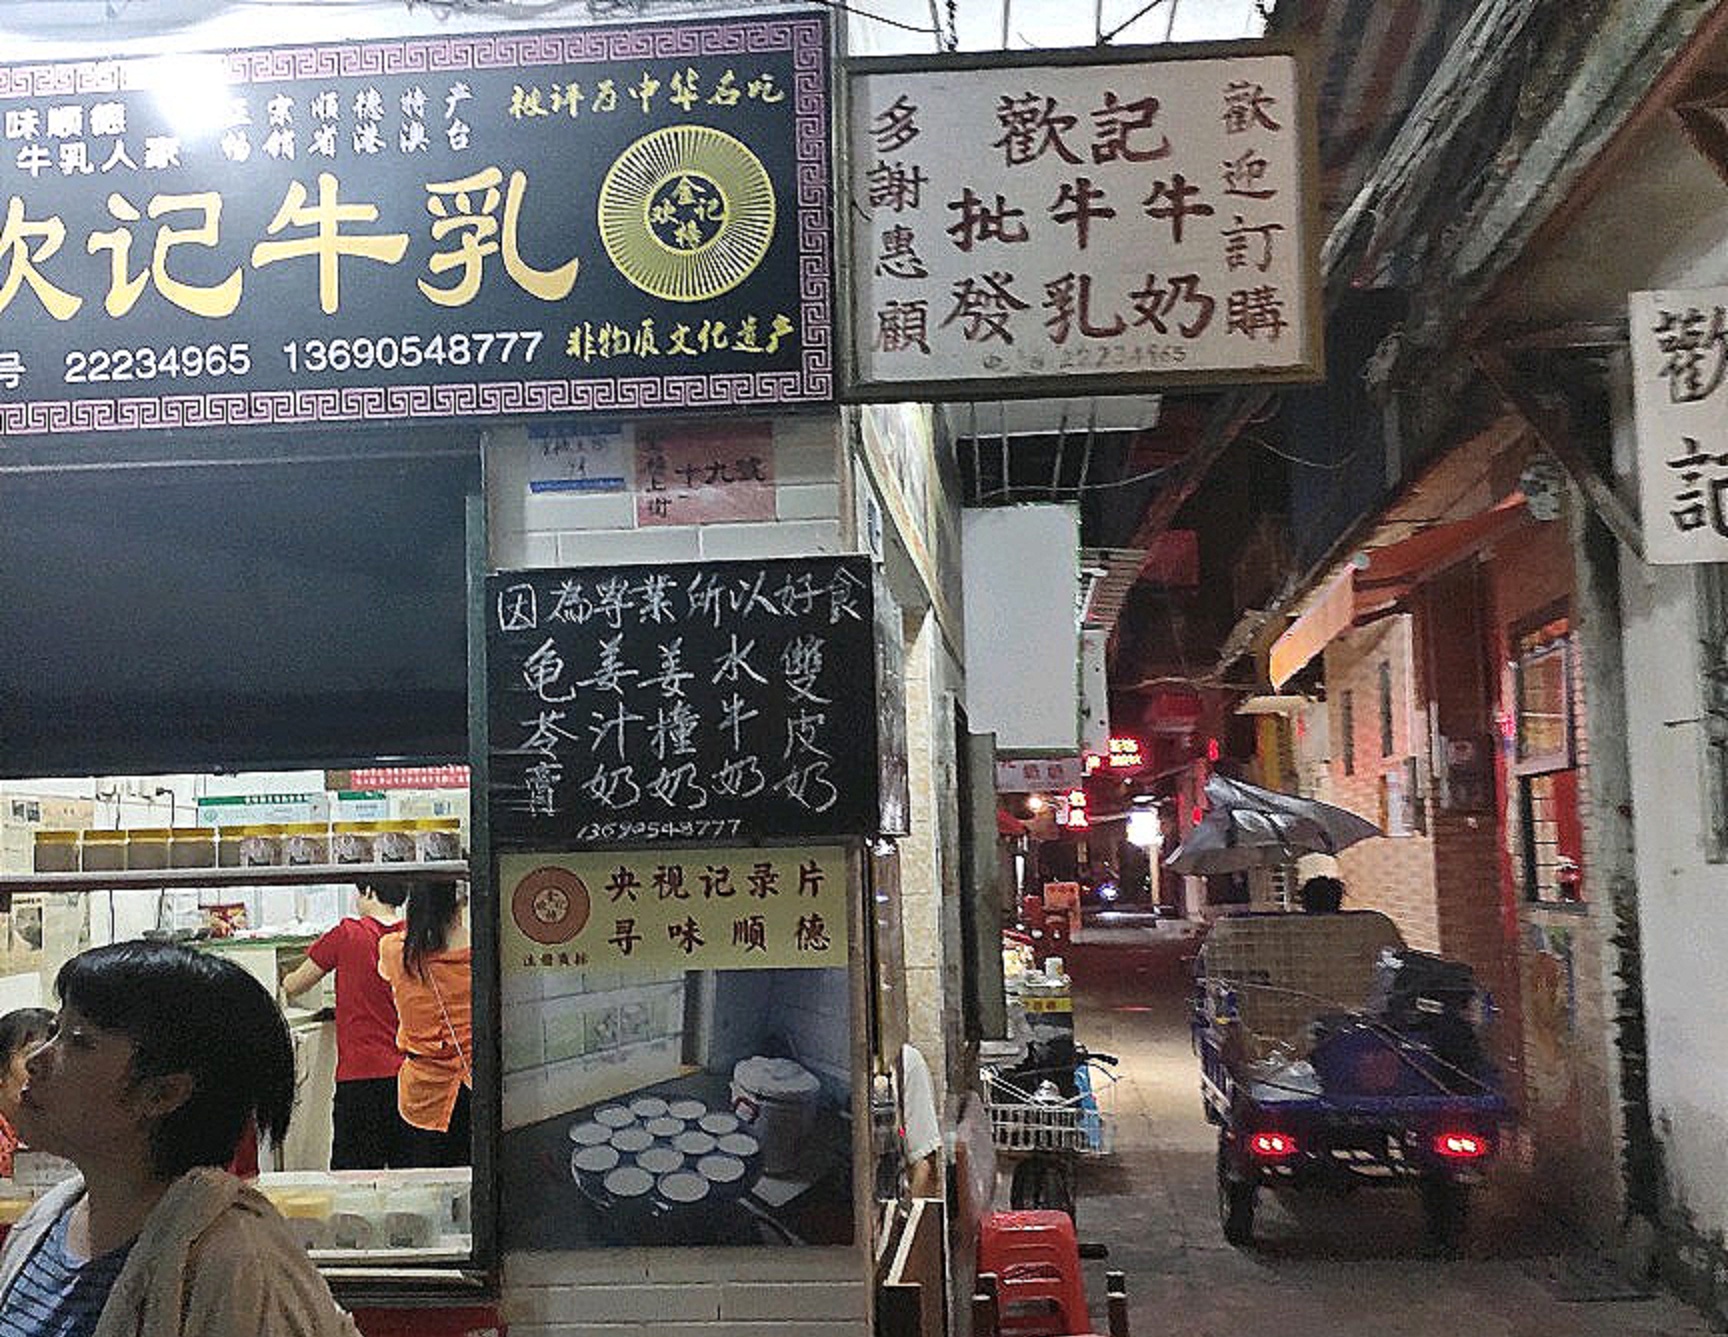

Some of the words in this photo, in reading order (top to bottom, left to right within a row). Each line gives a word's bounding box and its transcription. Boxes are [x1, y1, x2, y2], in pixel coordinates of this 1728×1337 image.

[991, 90, 1174, 167] 歡記
[1220, 80, 1289, 345] 歡迎訂購
[64, 342, 251, 384] 22234965
[282, 330, 543, 373] 13690548777
[710, 633, 770, 799] 水牛奶
[604, 859, 826, 903] 央视记录片
